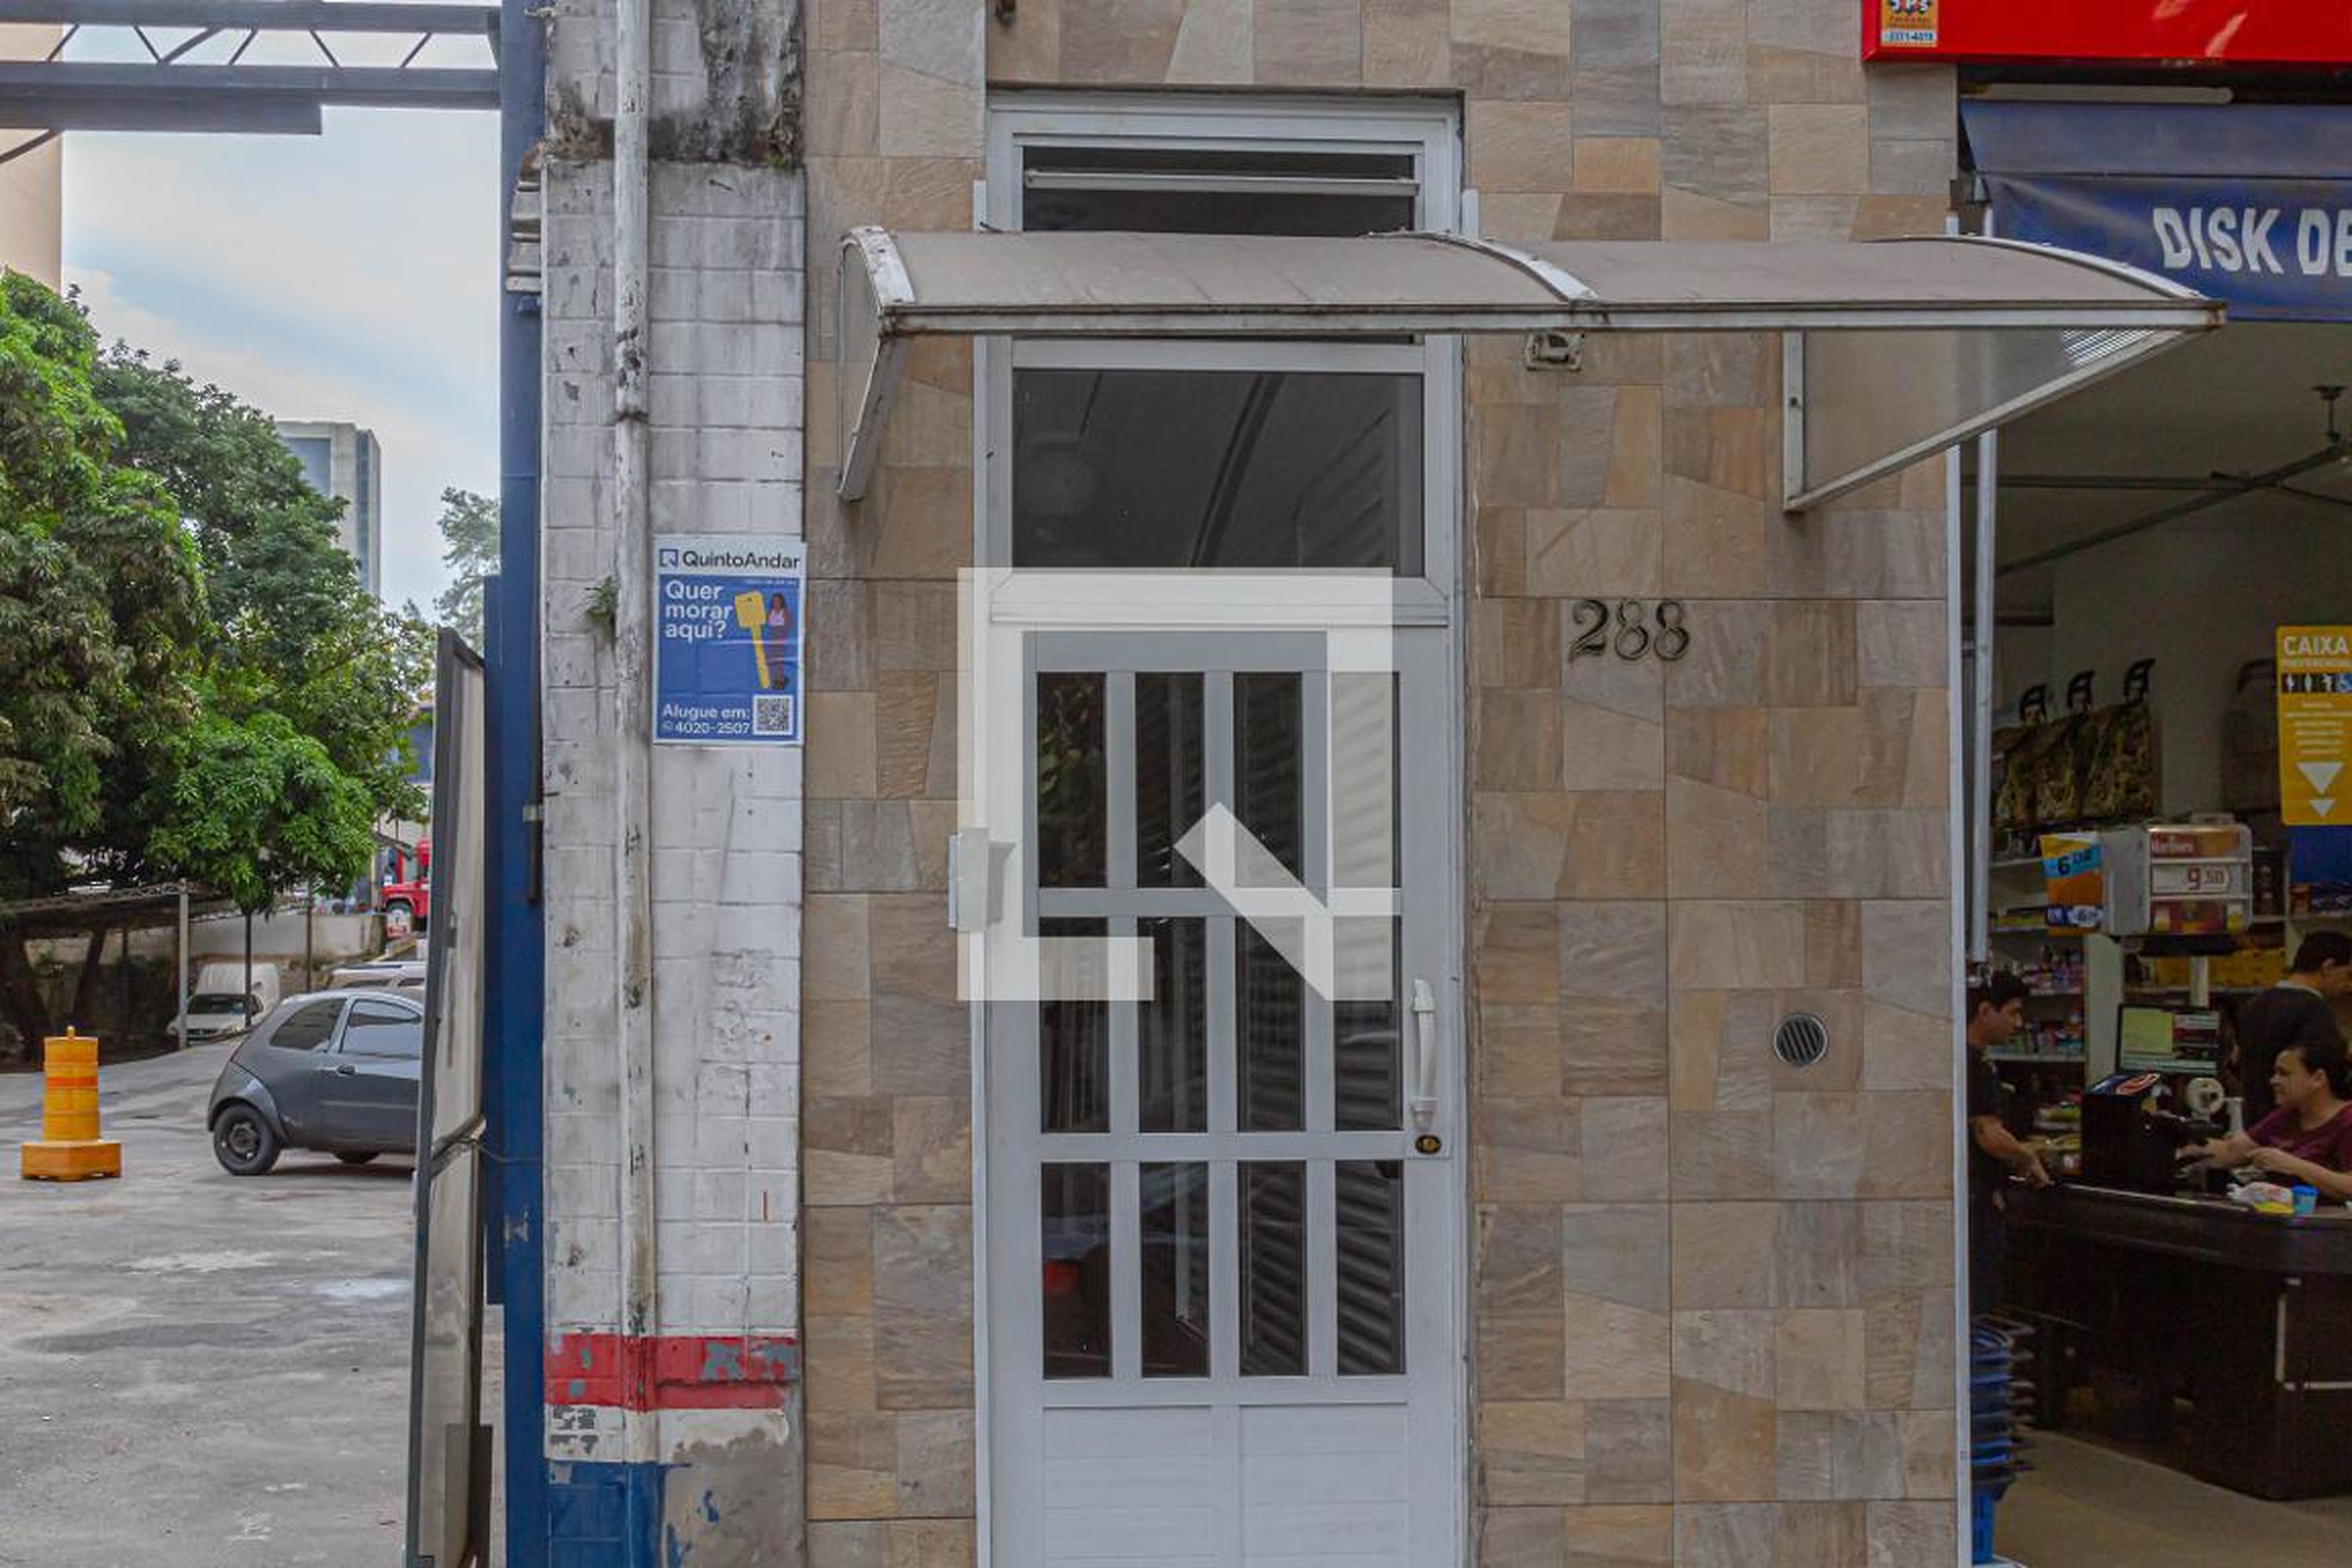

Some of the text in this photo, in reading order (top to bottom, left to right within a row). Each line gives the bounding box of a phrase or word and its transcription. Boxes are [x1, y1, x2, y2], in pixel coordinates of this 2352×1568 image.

[2153, 207, 2284, 274] DISK
[682, 551, 801, 569] QuintoAndar
[665, 580, 724, 600] Quer
[665, 602, 733, 620] morar
[665, 620, 727, 643] aqui?
[1568, 599, 1691, 662] 288
[2284, 636, 2349, 656] CAIXA
[662, 704, 751, 721] Alugue em:
